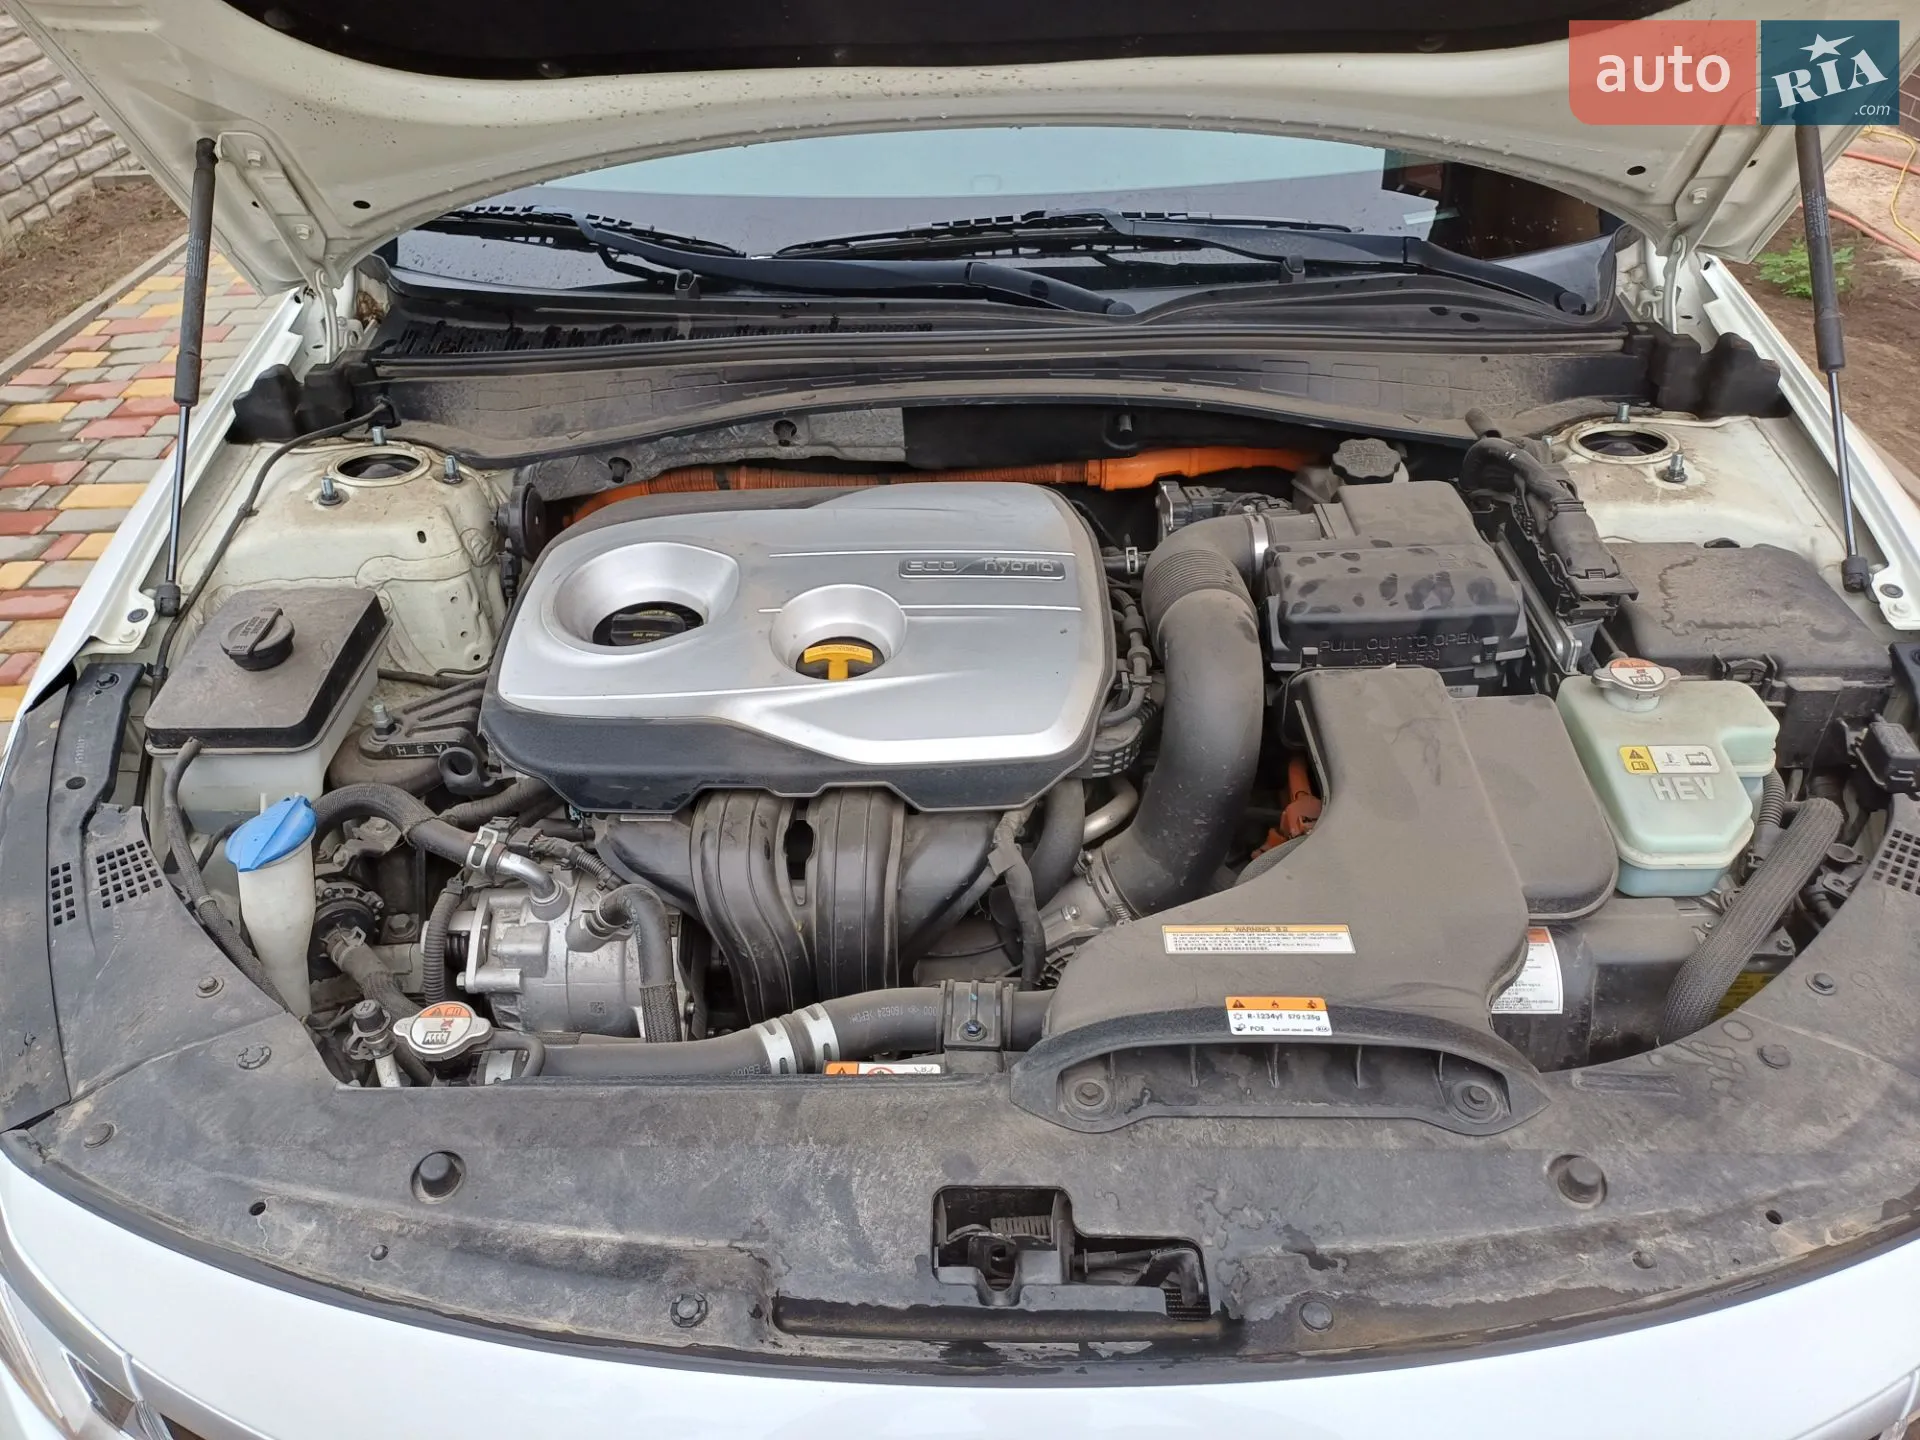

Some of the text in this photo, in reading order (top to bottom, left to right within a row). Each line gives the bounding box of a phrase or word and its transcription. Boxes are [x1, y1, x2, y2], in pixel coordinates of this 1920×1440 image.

[906, 557, 1055, 574] ECO hybrid
[1319, 632, 1480, 653] PULL OUT TO OPEN
[1648, 776, 1715, 801] HEV
